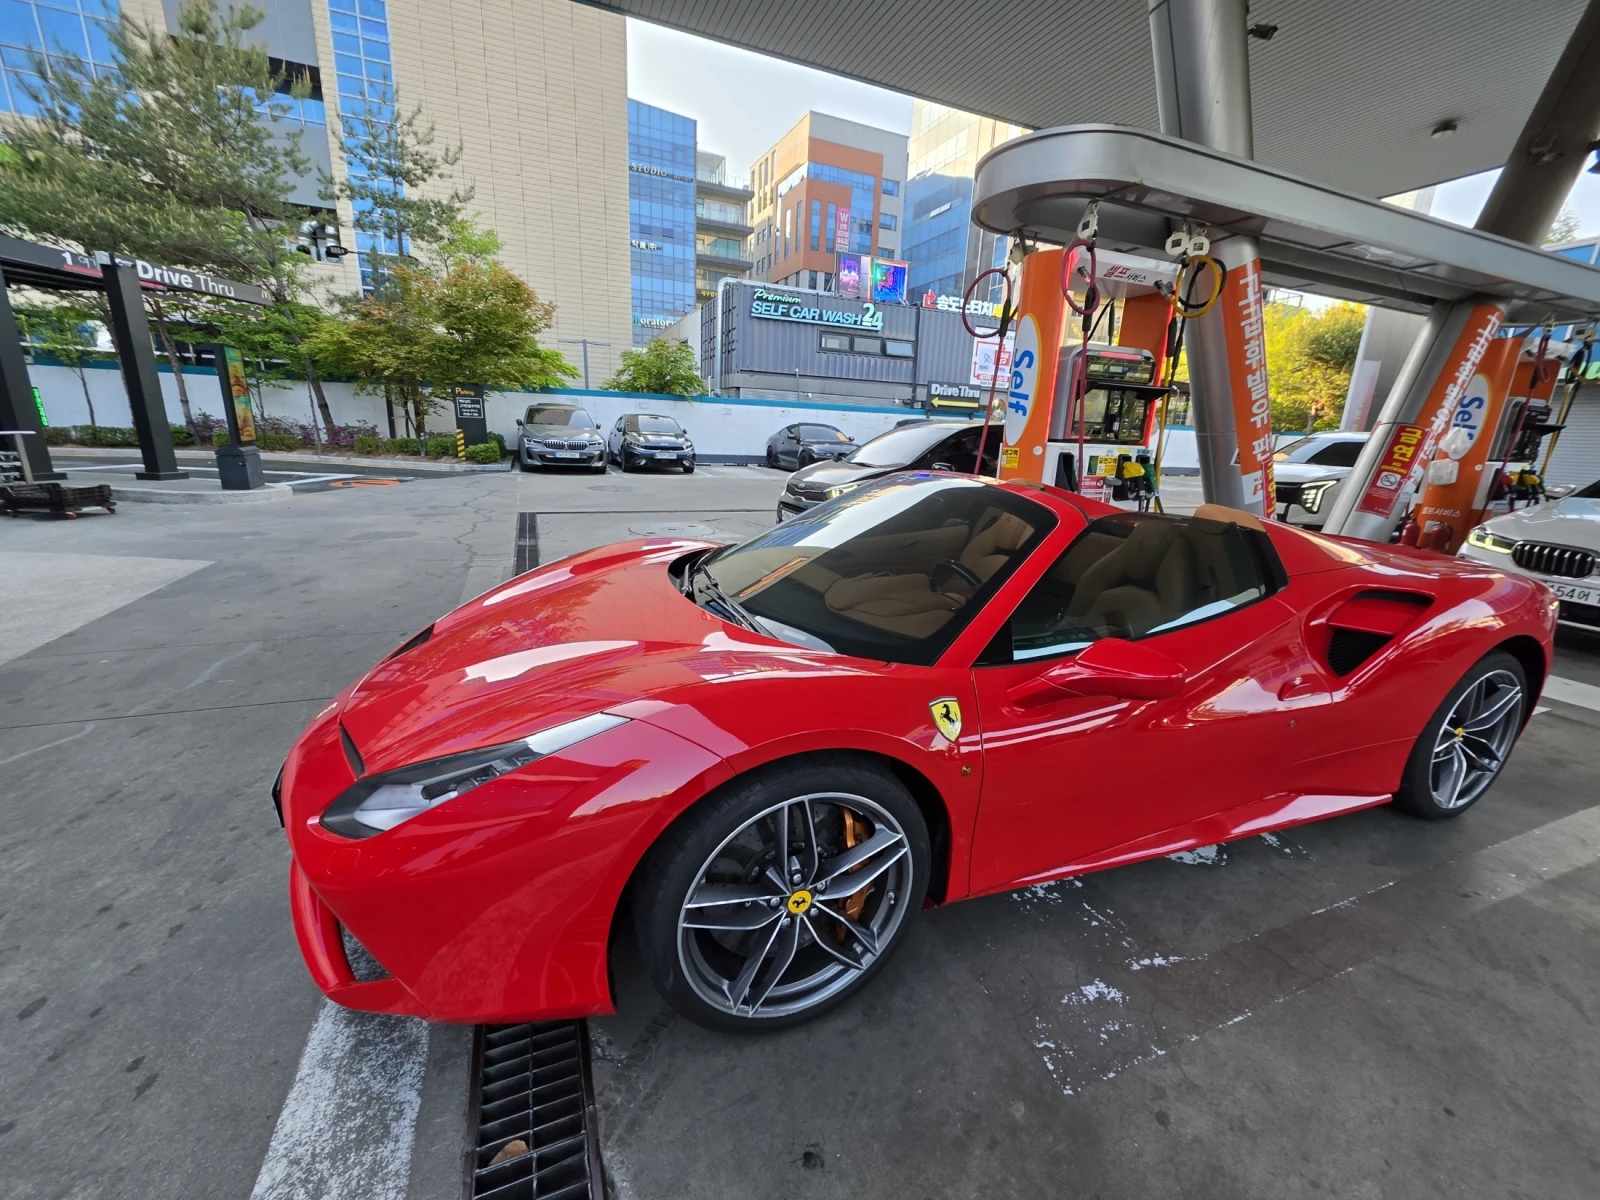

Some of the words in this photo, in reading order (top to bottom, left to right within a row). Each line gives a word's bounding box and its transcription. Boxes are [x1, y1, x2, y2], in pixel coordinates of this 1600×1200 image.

[631, 162, 667, 177] STUDIO
[136, 259, 193, 289] Drive
[195, 273, 235, 298] Thru
[1103, 265, 1131, 279] 셀프
[754, 288, 802, 303] Premium
[751, 301, 788, 316] SELF
[789, 305, 820, 320] CAR
[822, 309, 862, 325] WASH
[861, 303, 883, 330] 24
[1238, 272, 1270, 429] 고급휘발유
[455, 387, 475, 396] Parking
[931, 384, 959, 397] Drive
[959, 385, 980, 399] Thru
[1008, 349, 1034, 417] Self
[1393, 427, 1423, 462] 금연
[1549, 584, 1591, 602] 54어
